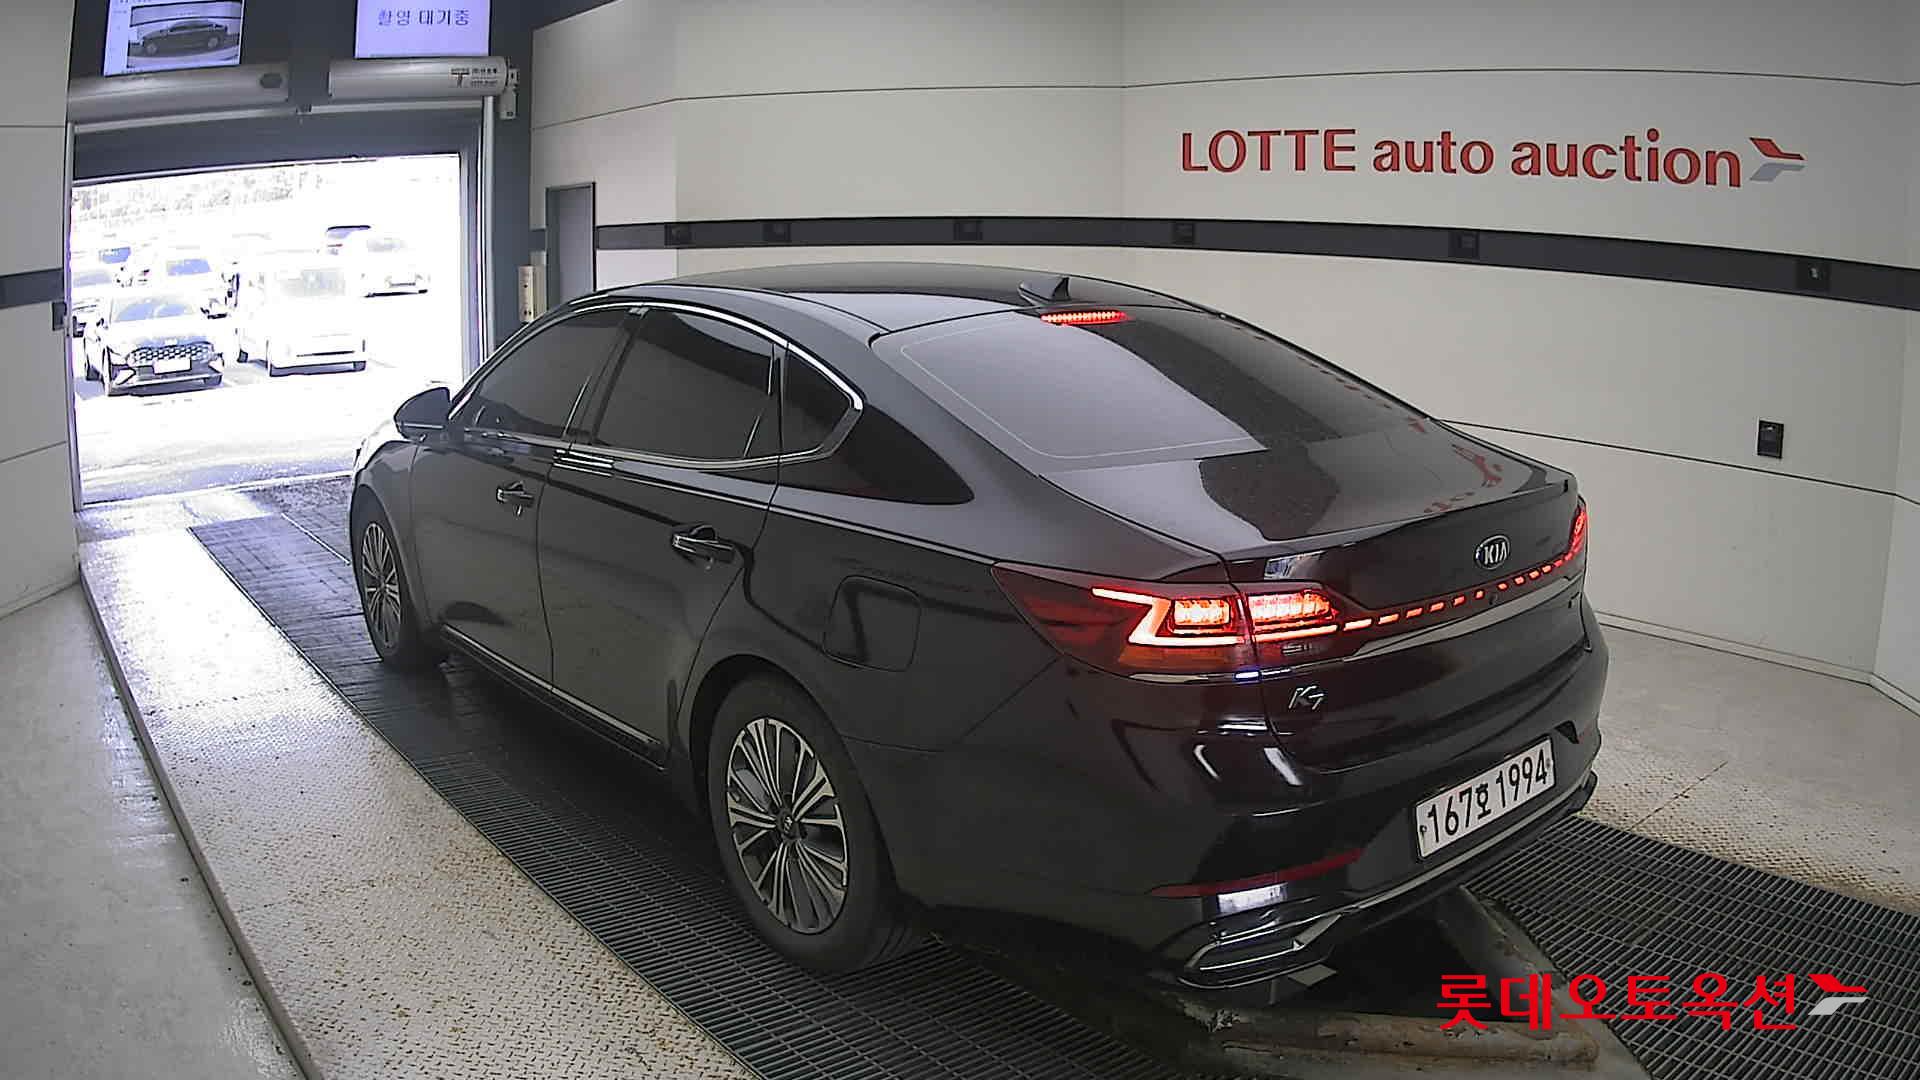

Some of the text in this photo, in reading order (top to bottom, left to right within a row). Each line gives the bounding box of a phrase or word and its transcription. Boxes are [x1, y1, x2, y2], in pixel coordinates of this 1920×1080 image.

[419, 9, 470, 26] 대기중
[1181, 127, 1742, 188] LOTTE auto auction
[1483, 541, 1508, 565] KIA
[1287, 684, 1325, 711] K7
[1426, 748, 1549, 844] 167호 1994
